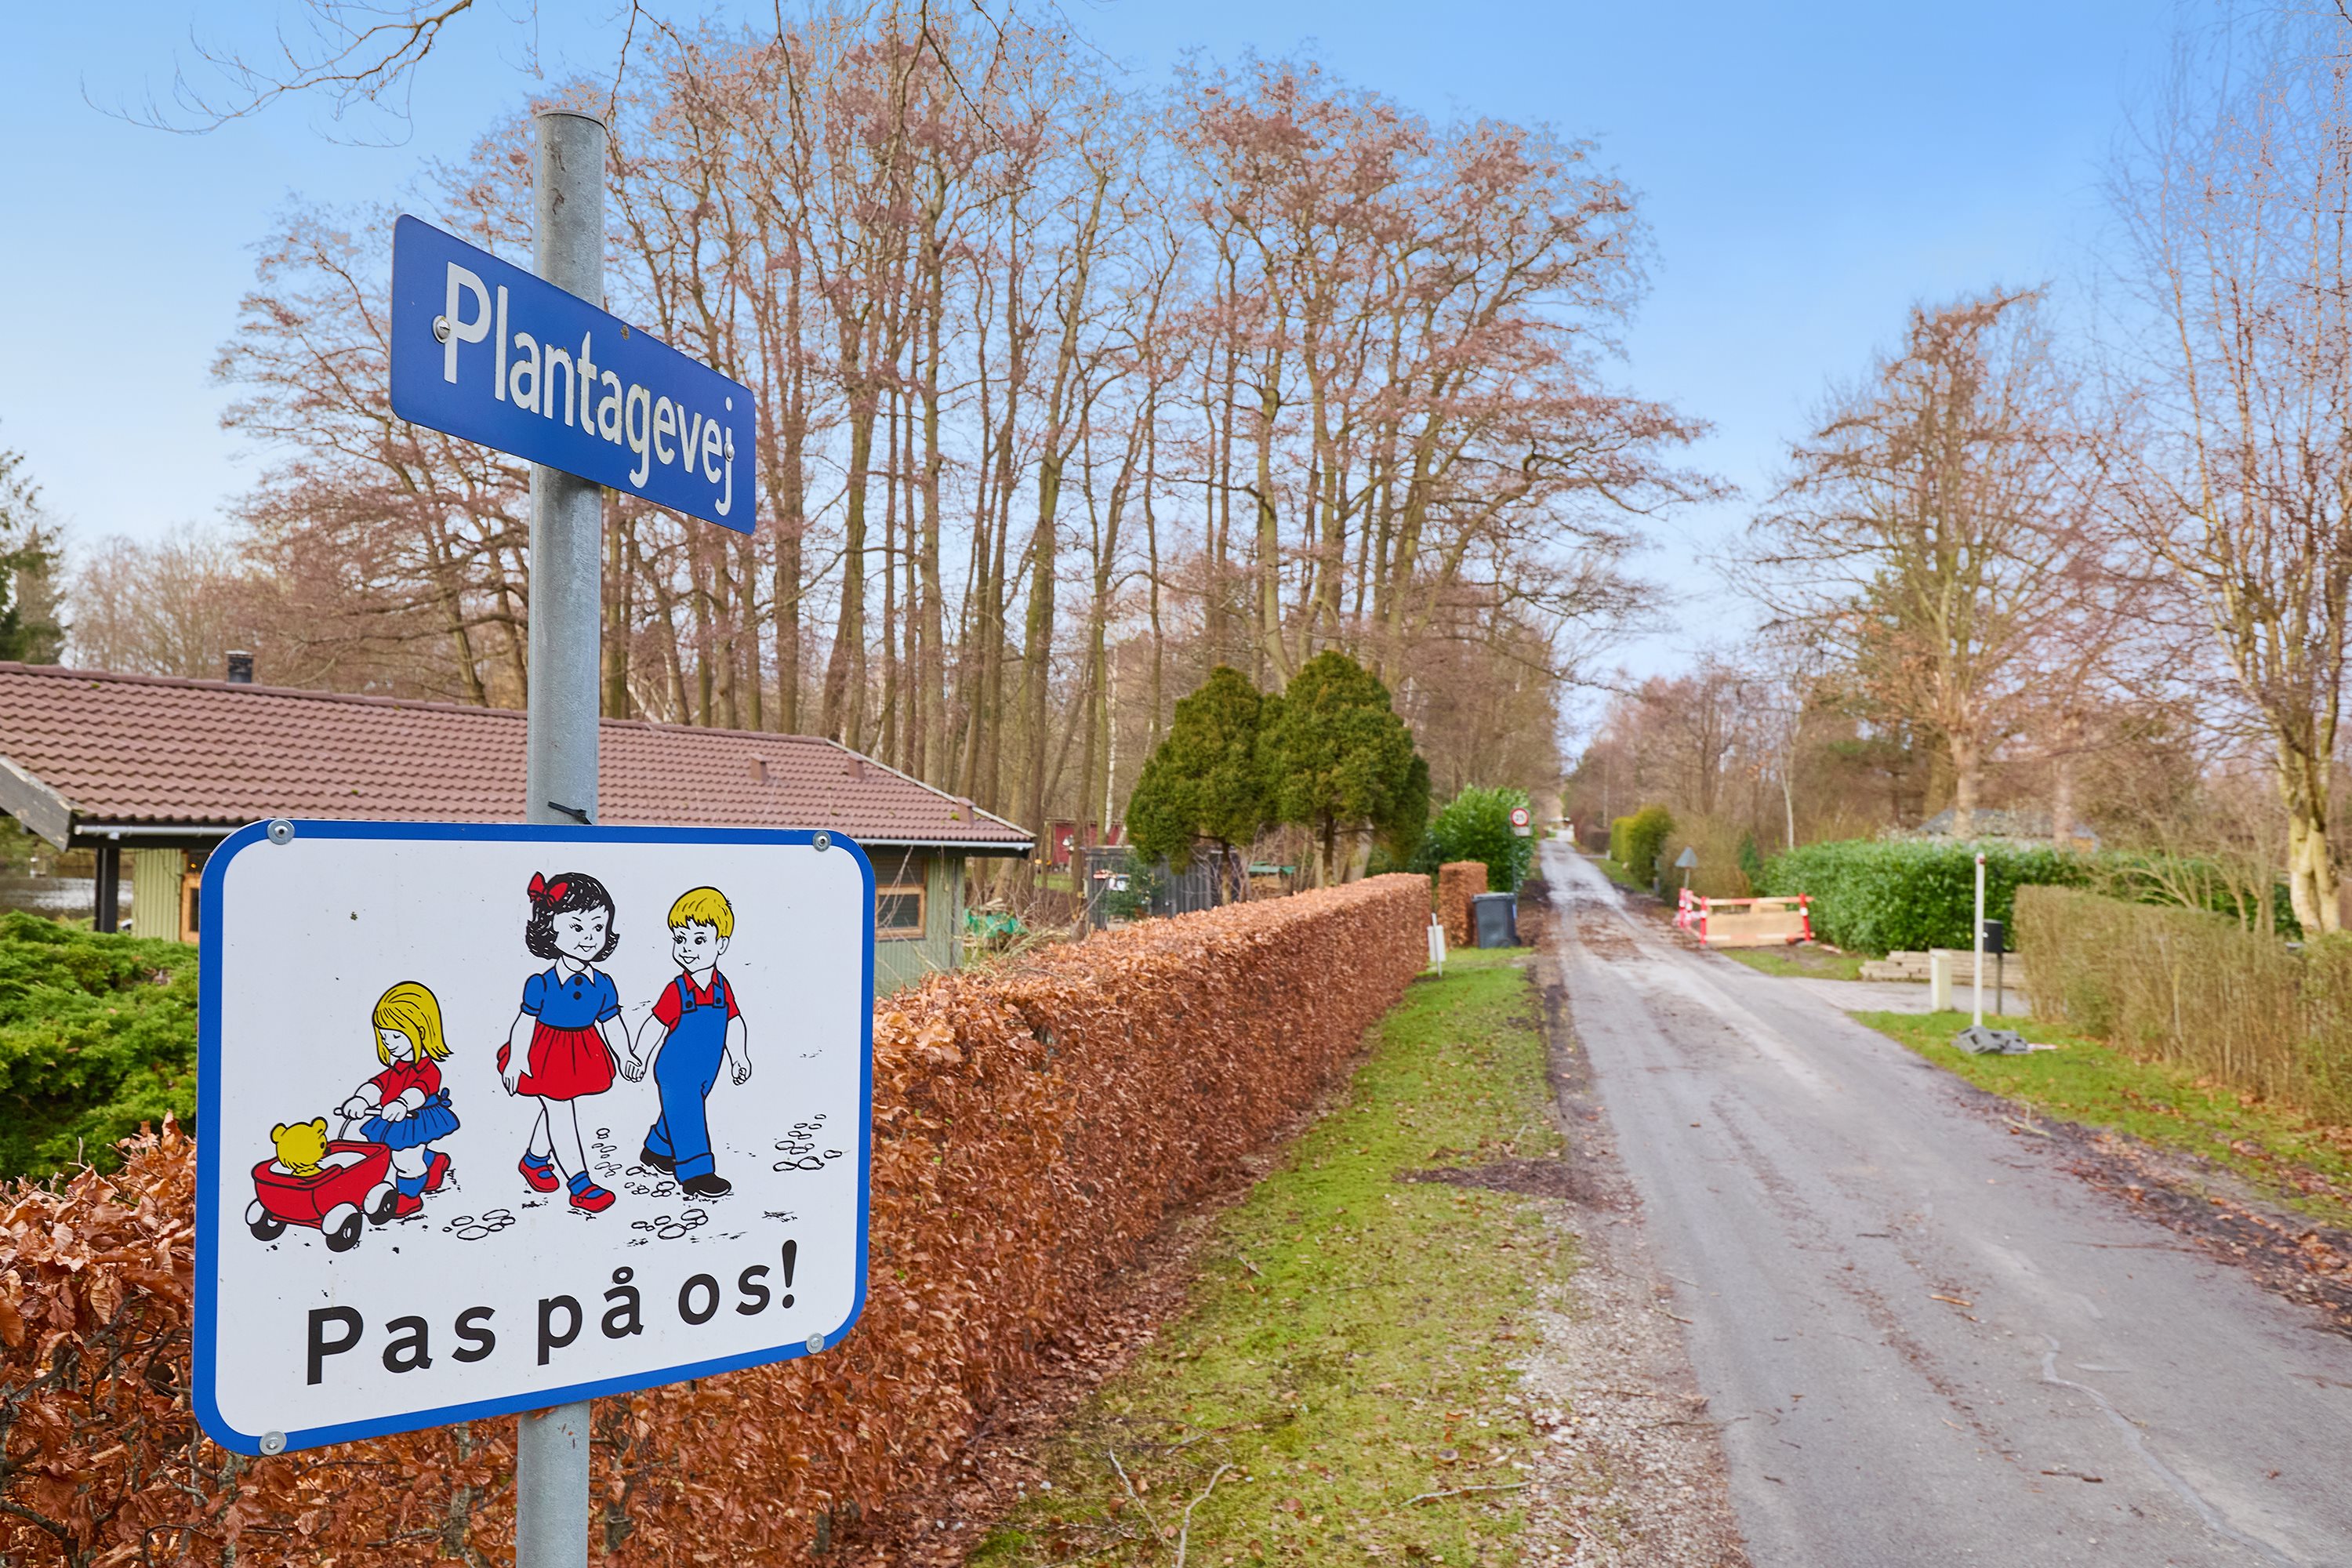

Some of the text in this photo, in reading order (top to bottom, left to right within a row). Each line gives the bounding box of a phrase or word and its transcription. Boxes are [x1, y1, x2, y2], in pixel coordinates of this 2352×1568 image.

[444, 261, 733, 516] Plantagevej
[307, 1240, 797, 1385] Pas på os!
